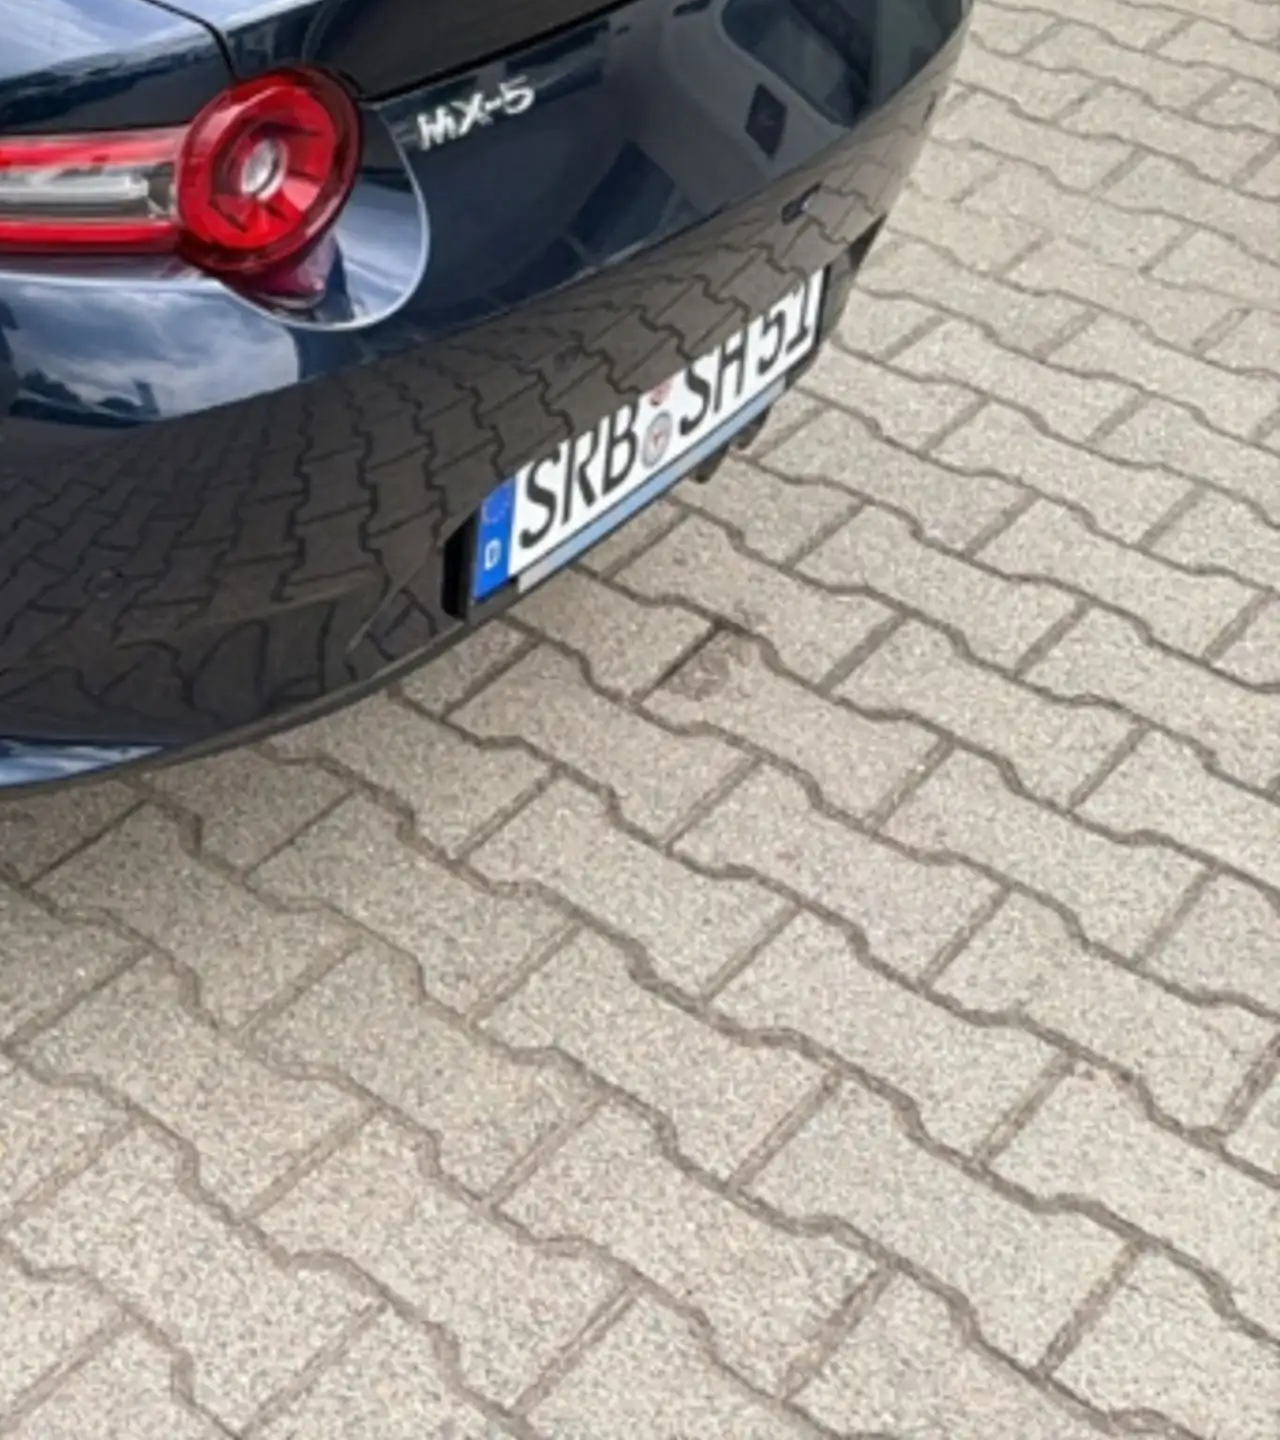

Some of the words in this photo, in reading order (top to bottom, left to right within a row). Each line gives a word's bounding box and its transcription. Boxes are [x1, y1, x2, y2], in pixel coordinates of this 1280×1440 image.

[416, 74, 536, 152] MX-5
[518, 400, 640, 550] SRB
[483, 538, 502, 572] D
